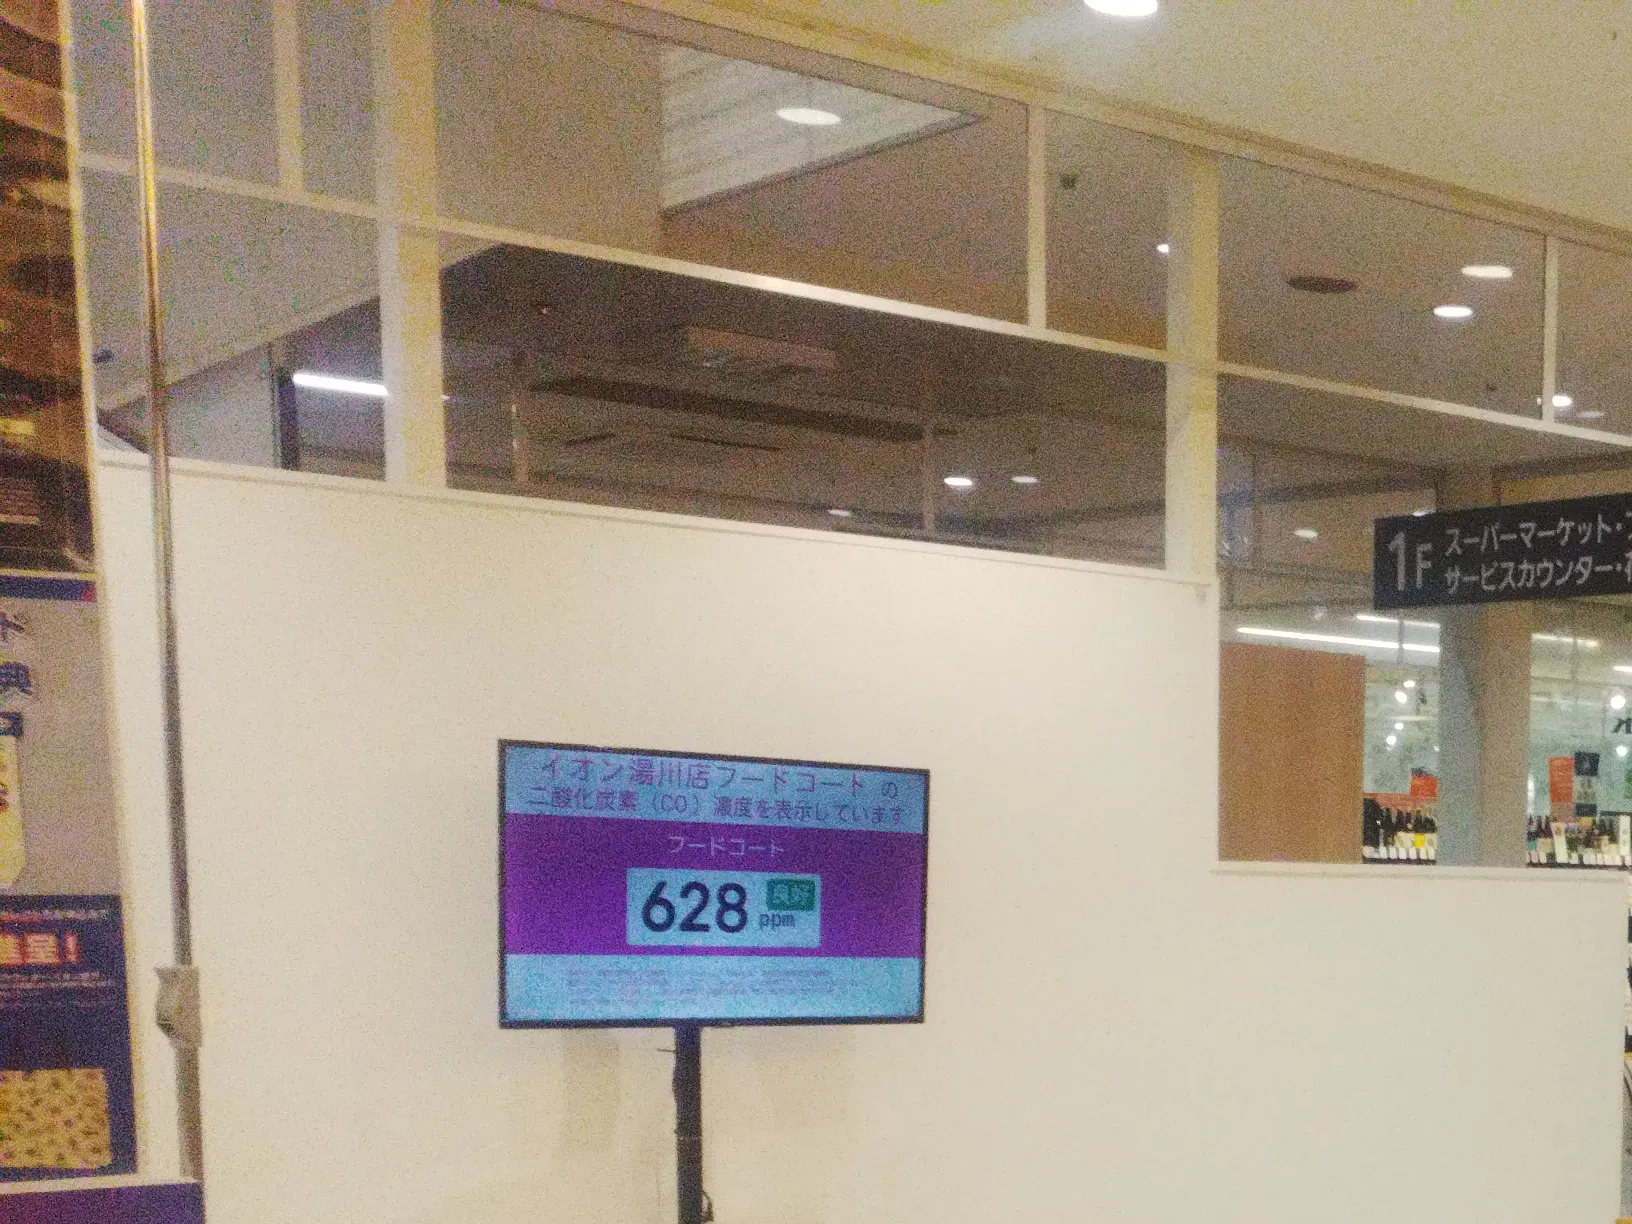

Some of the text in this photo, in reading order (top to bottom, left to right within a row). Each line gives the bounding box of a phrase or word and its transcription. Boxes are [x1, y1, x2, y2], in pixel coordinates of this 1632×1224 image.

[1388, 531, 1433, 591] 1F
[669, 835, 785, 857] フードコート
[642, 881, 748, 933] 628
[758, 913, 796, 931] ppm
